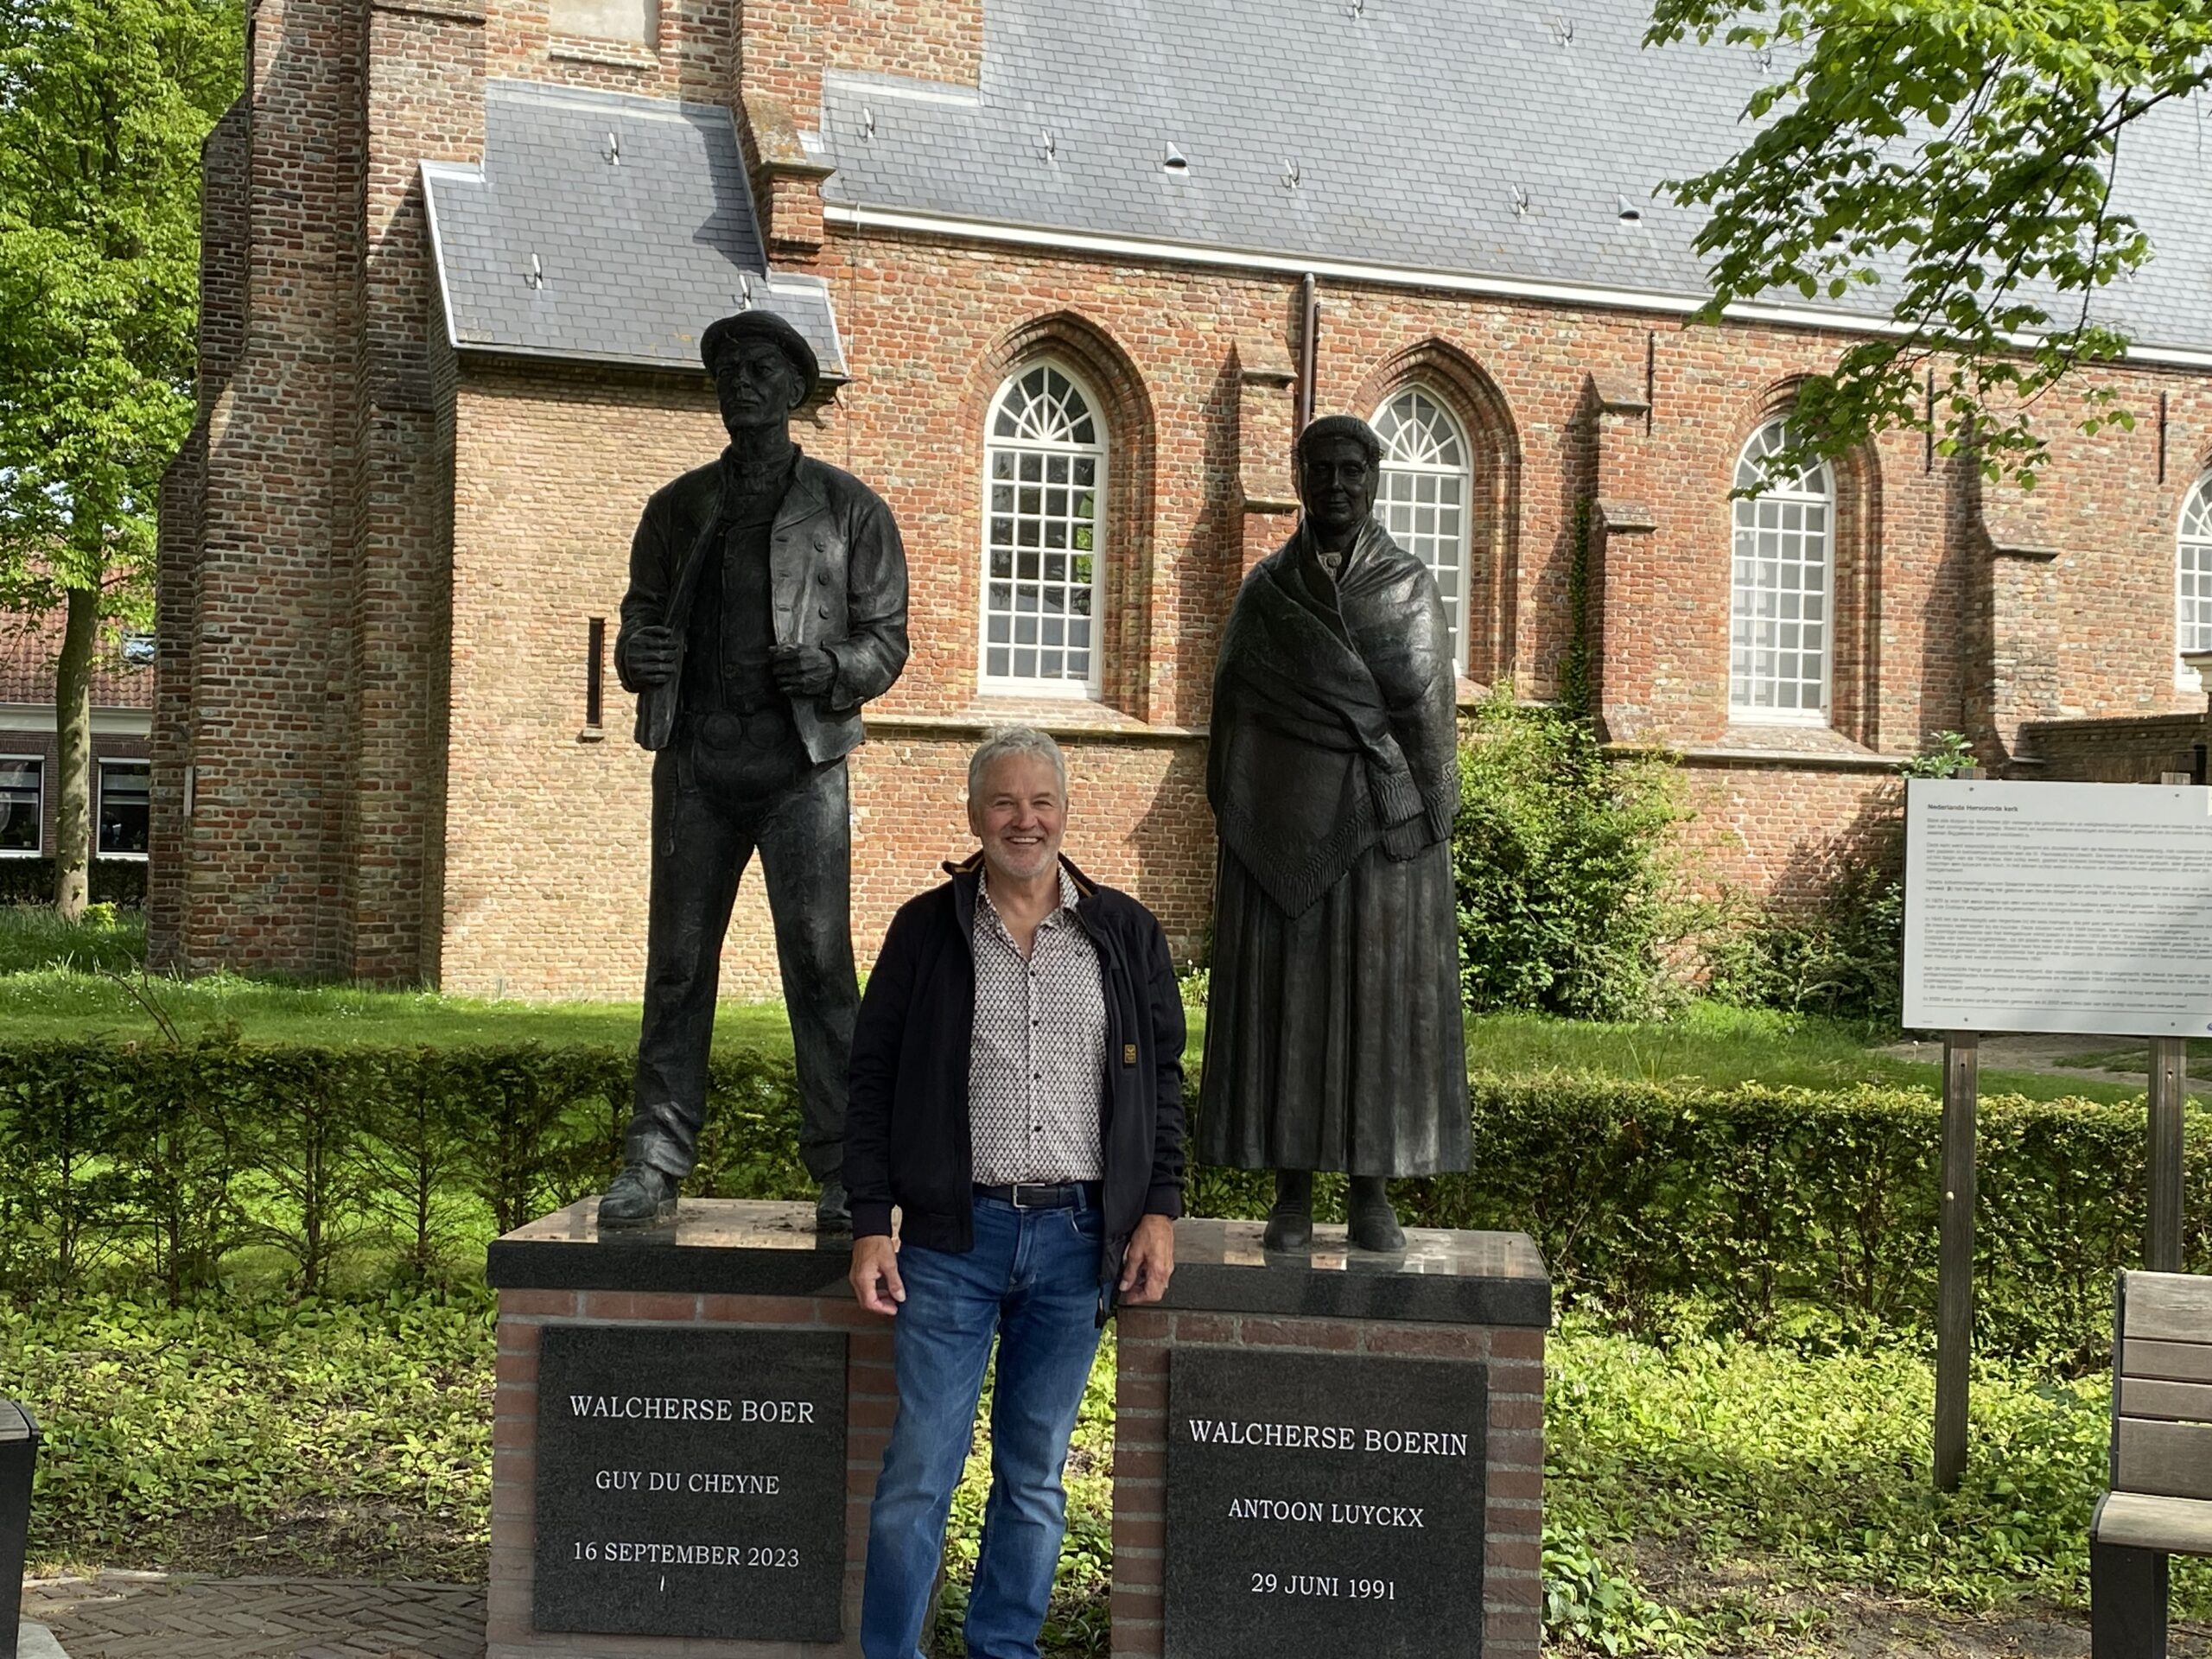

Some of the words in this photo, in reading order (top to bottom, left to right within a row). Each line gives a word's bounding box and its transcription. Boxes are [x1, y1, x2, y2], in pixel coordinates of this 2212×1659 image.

[570, 1395, 732, 1421] WALCHERSE
[741, 1401, 815, 1423] BOER
[1189, 1420, 1356, 1451] WALCHERSE
[1364, 1429, 1468, 1456] BOERIN
[596, 1471, 642, 1490] GUY
[649, 1472, 681, 1491] DU
[689, 1474, 779, 1495] CHEYNE
[1228, 1498, 1324, 1522] ANTOON
[1331, 1504, 1425, 1528] LUYCKX
[574, 1542, 597, 1560] 16
[605, 1542, 741, 1566] SEPTEMBER
[747, 1548, 799, 1567] 2023
[1251, 1573, 1277, 1593] 29
[1284, 1575, 1339, 1597] JUNI
[1349, 1580, 1395, 1600] 1991
